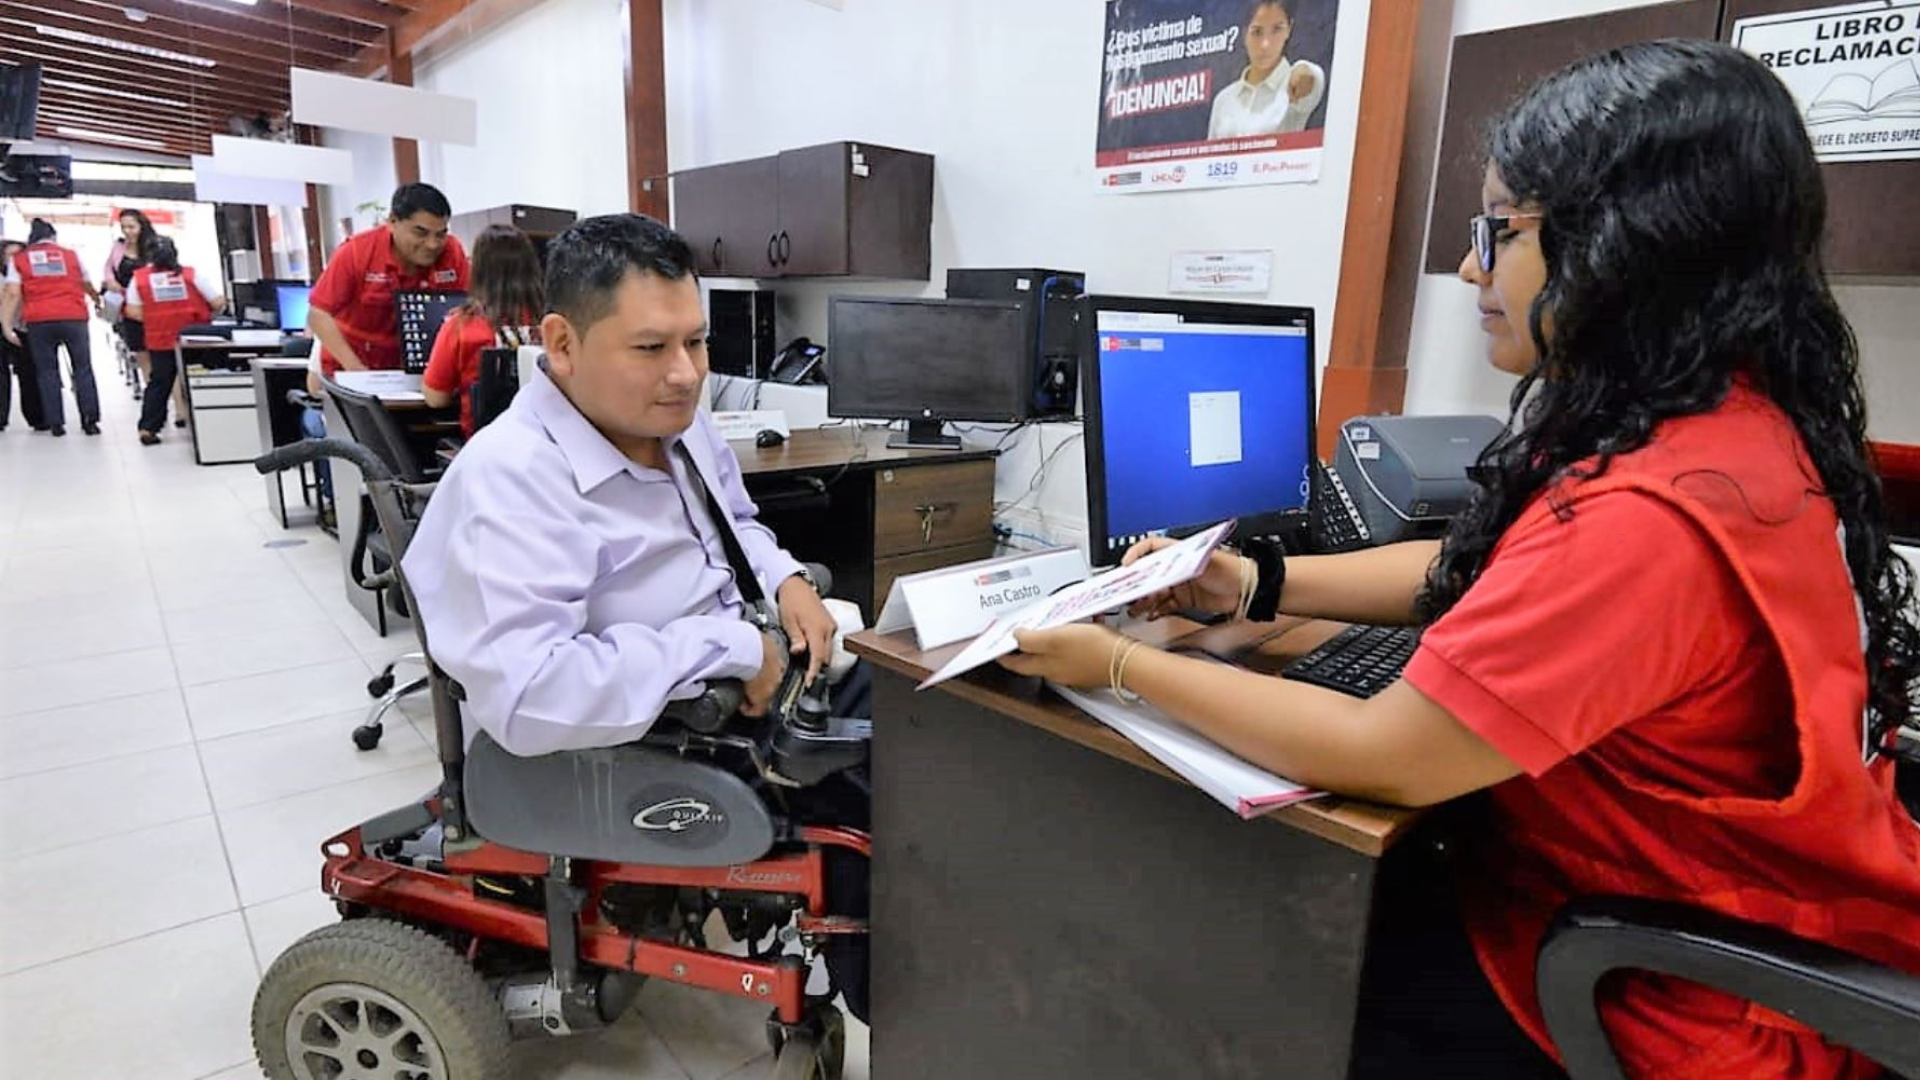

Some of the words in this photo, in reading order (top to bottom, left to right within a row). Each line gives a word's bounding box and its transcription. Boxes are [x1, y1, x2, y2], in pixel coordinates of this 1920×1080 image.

[1186, 14, 1203, 36] de
[1815, 14, 1904, 40] LIBRO
[1185, 26, 1240, 57] sexual?
[1110, 72, 1206, 118] ¡DENUNCIA!
[1848, 130, 1889, 145] DECRETO
[1206, 161, 1238, 177] 1819
[979, 593, 1004, 609] Ana
[1003, 584, 1041, 603] Castro
